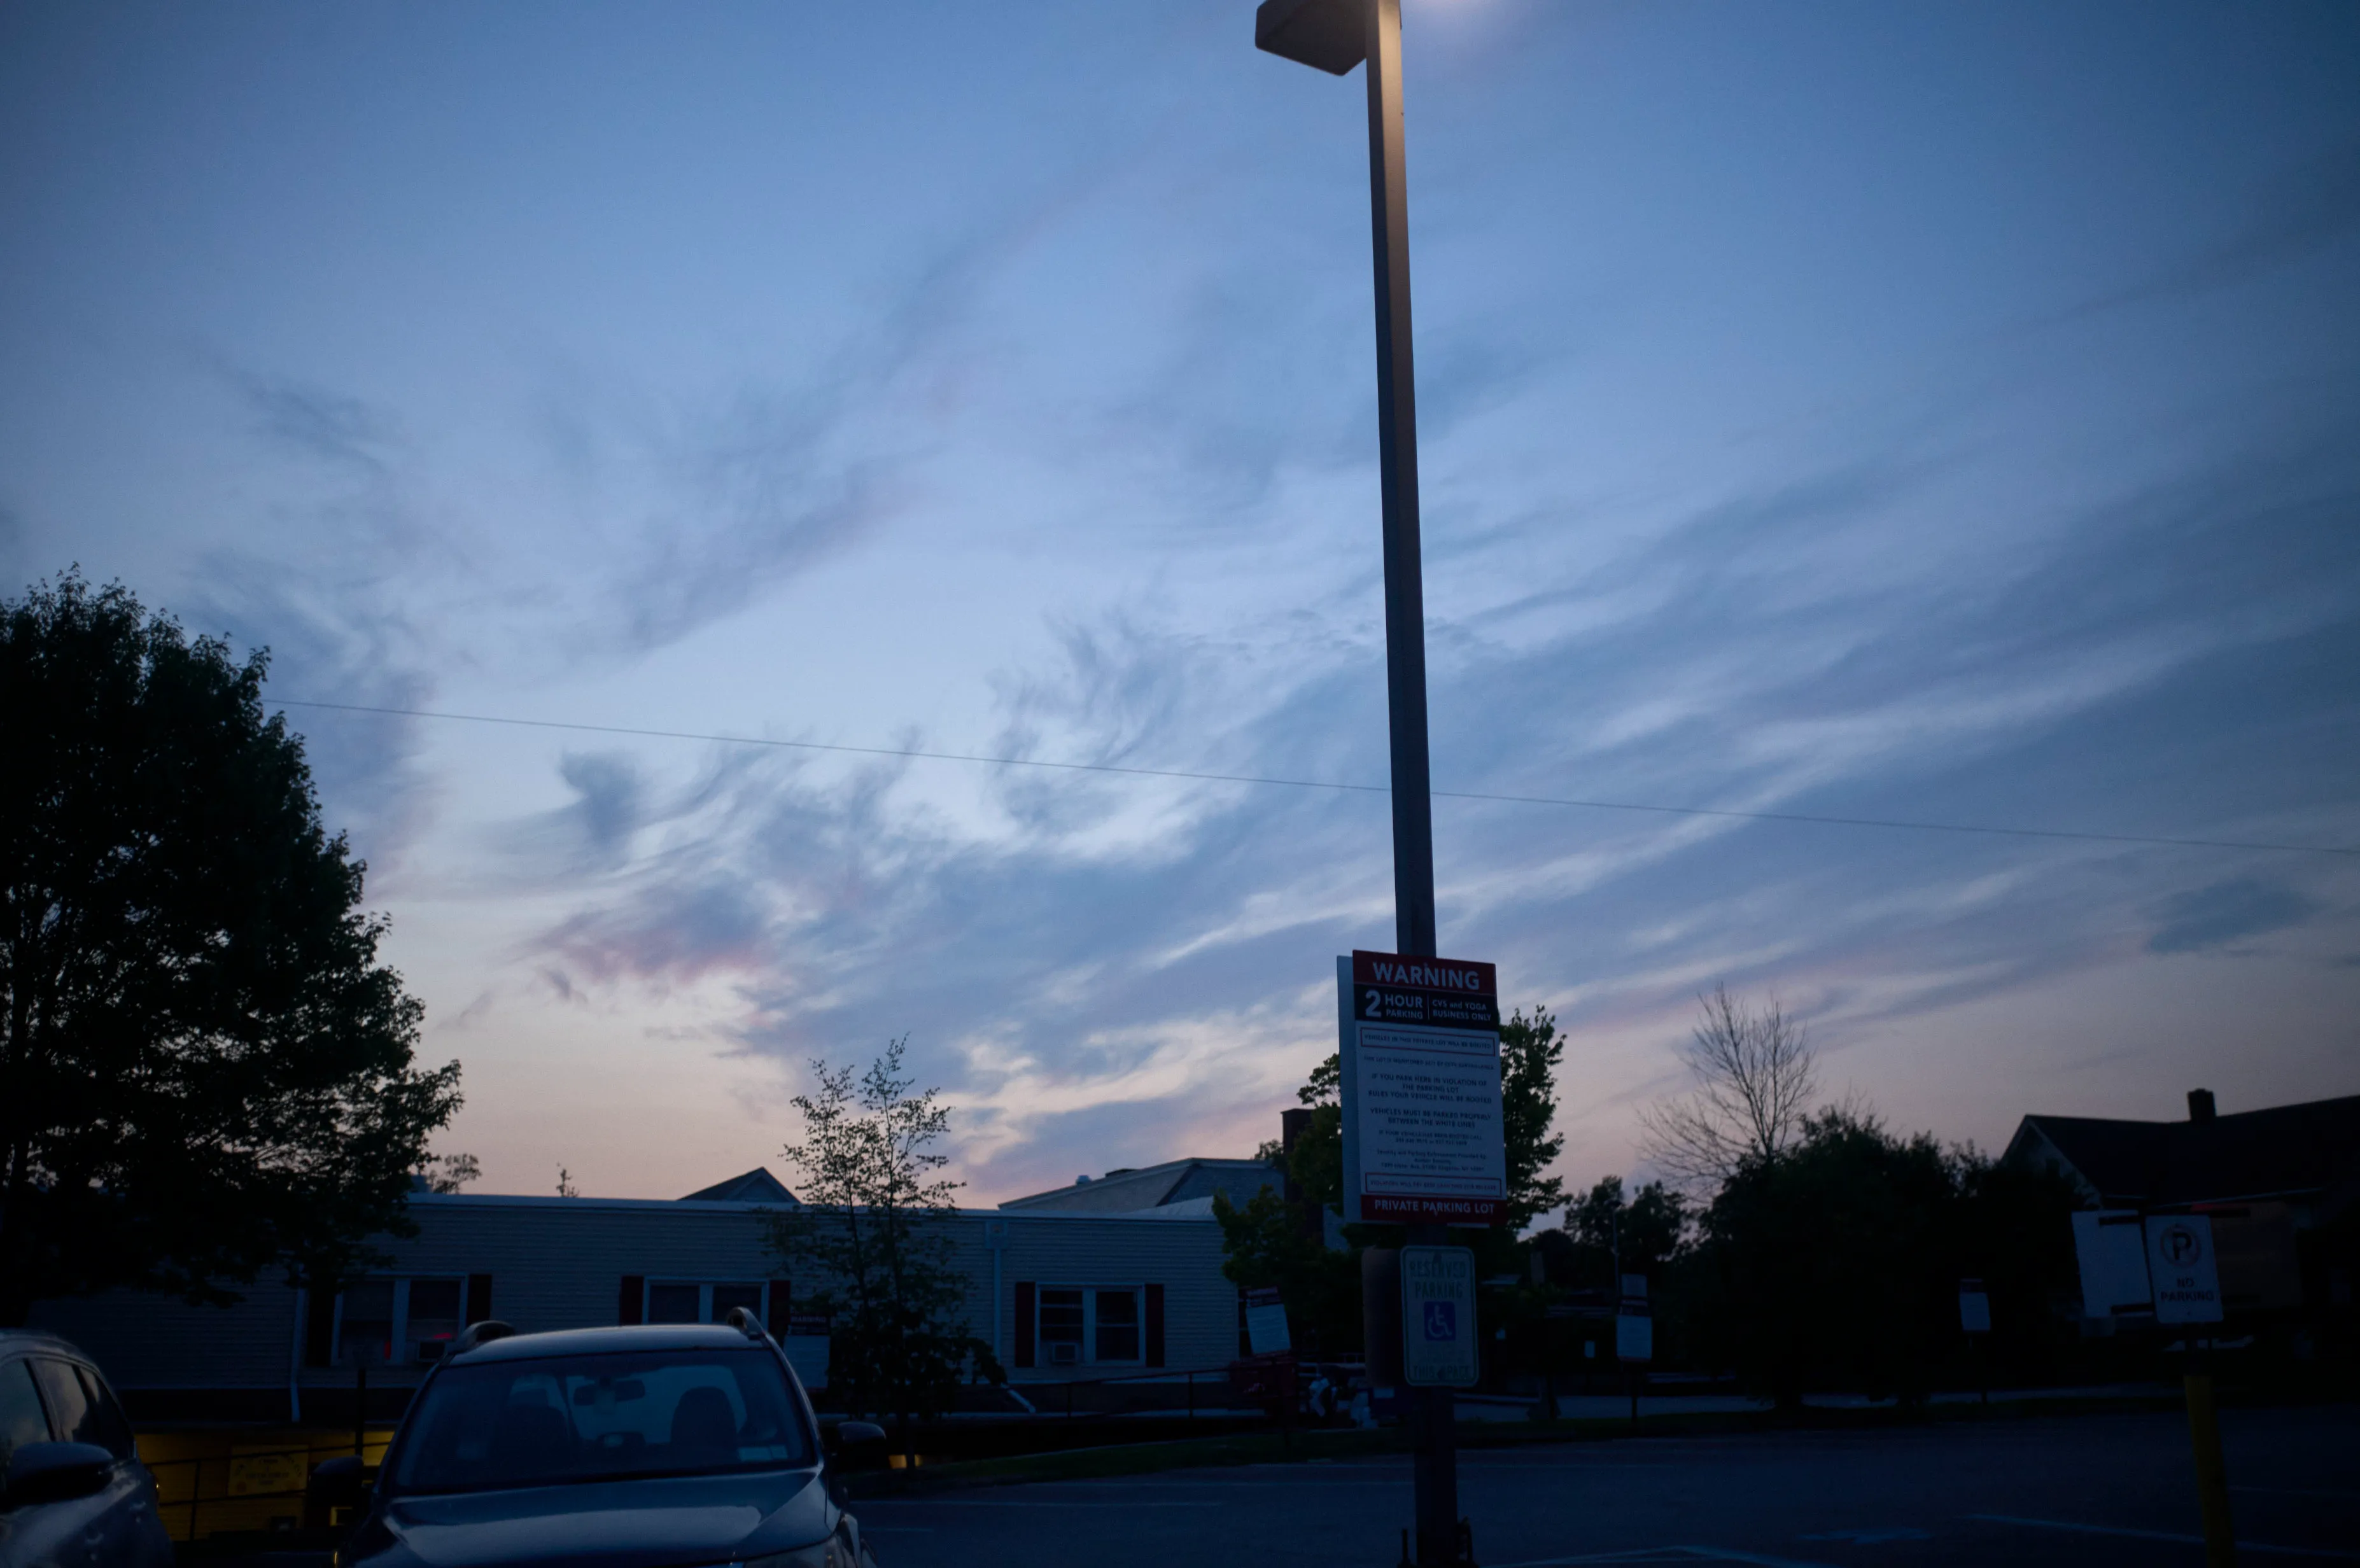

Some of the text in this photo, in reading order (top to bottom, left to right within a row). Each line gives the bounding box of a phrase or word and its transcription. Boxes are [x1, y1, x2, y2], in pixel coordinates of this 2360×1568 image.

[1372, 961, 1480, 990] WARNING
[1365, 990, 1423, 1018] 2 HOUR
[1432, 998, 1487, 1011] CVS and YOGA
[1386, 1009, 1423, 1019] PARKING
[1433, 1009, 1492, 1021] BUSINESS ONLY
[1442, 1077, 1477, 1086] VIOLATION
[1410, 1093, 1437, 1101] VEHICLE
[1465, 1096, 1492, 1104] BOOTED
[1370, 1107, 1401, 1116] VEHICLES
[1460, 1112, 1491, 1120] PROPERLY
[1375, 1199, 1494, 1215] PRIVATE PARKING LOT
[1409, 1260, 1466, 1278] RESERVED
[2177, 1277, 2195, 1288] NO
[1415, 1281, 1463, 1299] PARKING
[2160, 1290, 2215, 1302] PARKING
[1414, 1364, 1470, 1380] THIS PACE
